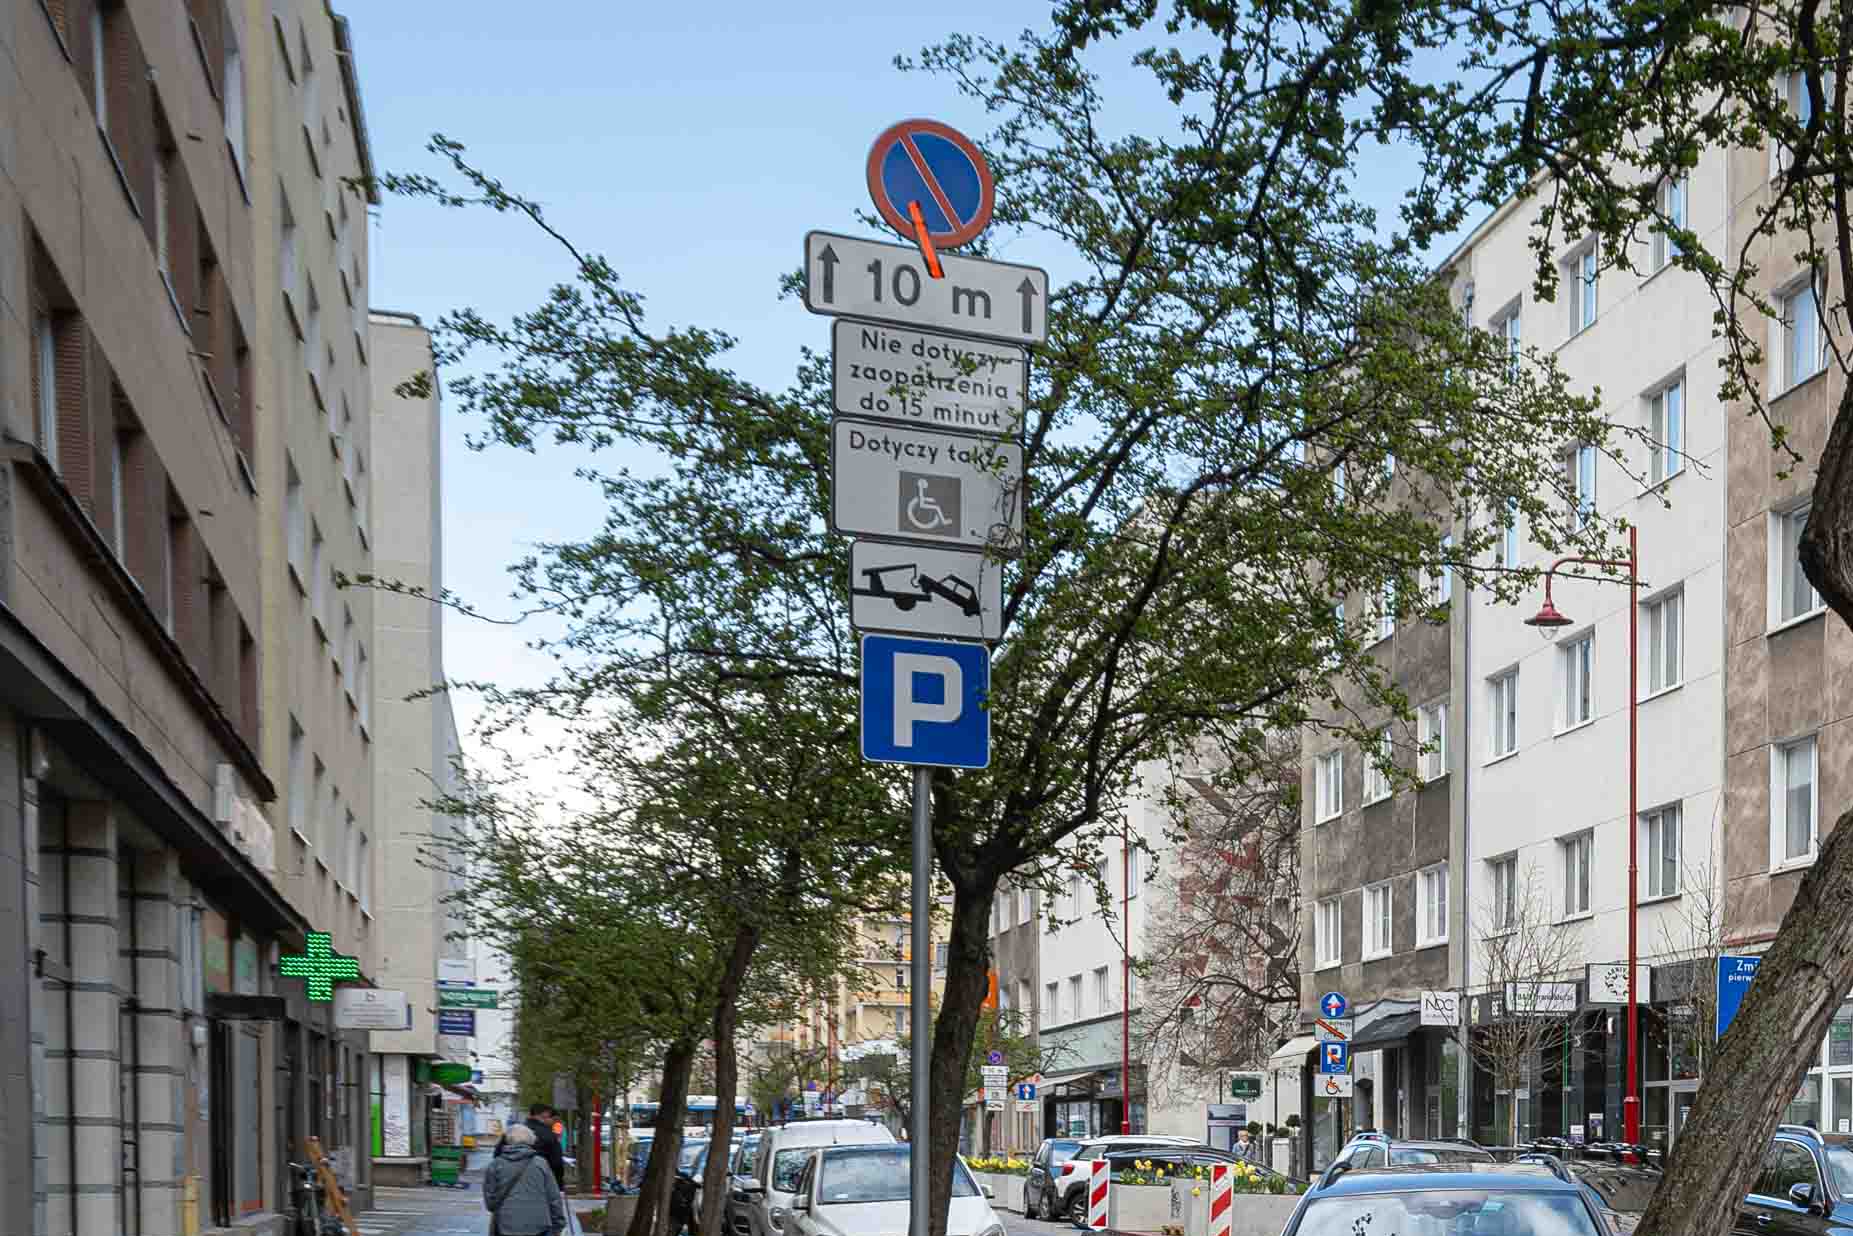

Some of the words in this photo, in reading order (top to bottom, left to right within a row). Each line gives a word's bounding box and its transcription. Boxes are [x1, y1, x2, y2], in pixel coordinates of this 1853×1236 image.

[867, 259, 921, 306] 10
[952, 285, 992, 319] m
[861, 328, 901, 354] Nie
[911, 338, 1000, 374] dotyczy
[850, 363, 1009, 400] zaopatrzenia
[860, 392, 890, 413] do
[900, 396, 923, 417] 15
[933, 403, 1001, 427] minut
[850, 431, 939, 464] Dotyczy
[893, 652, 962, 748] P
[1728, 973, 1755, 983] pierw
